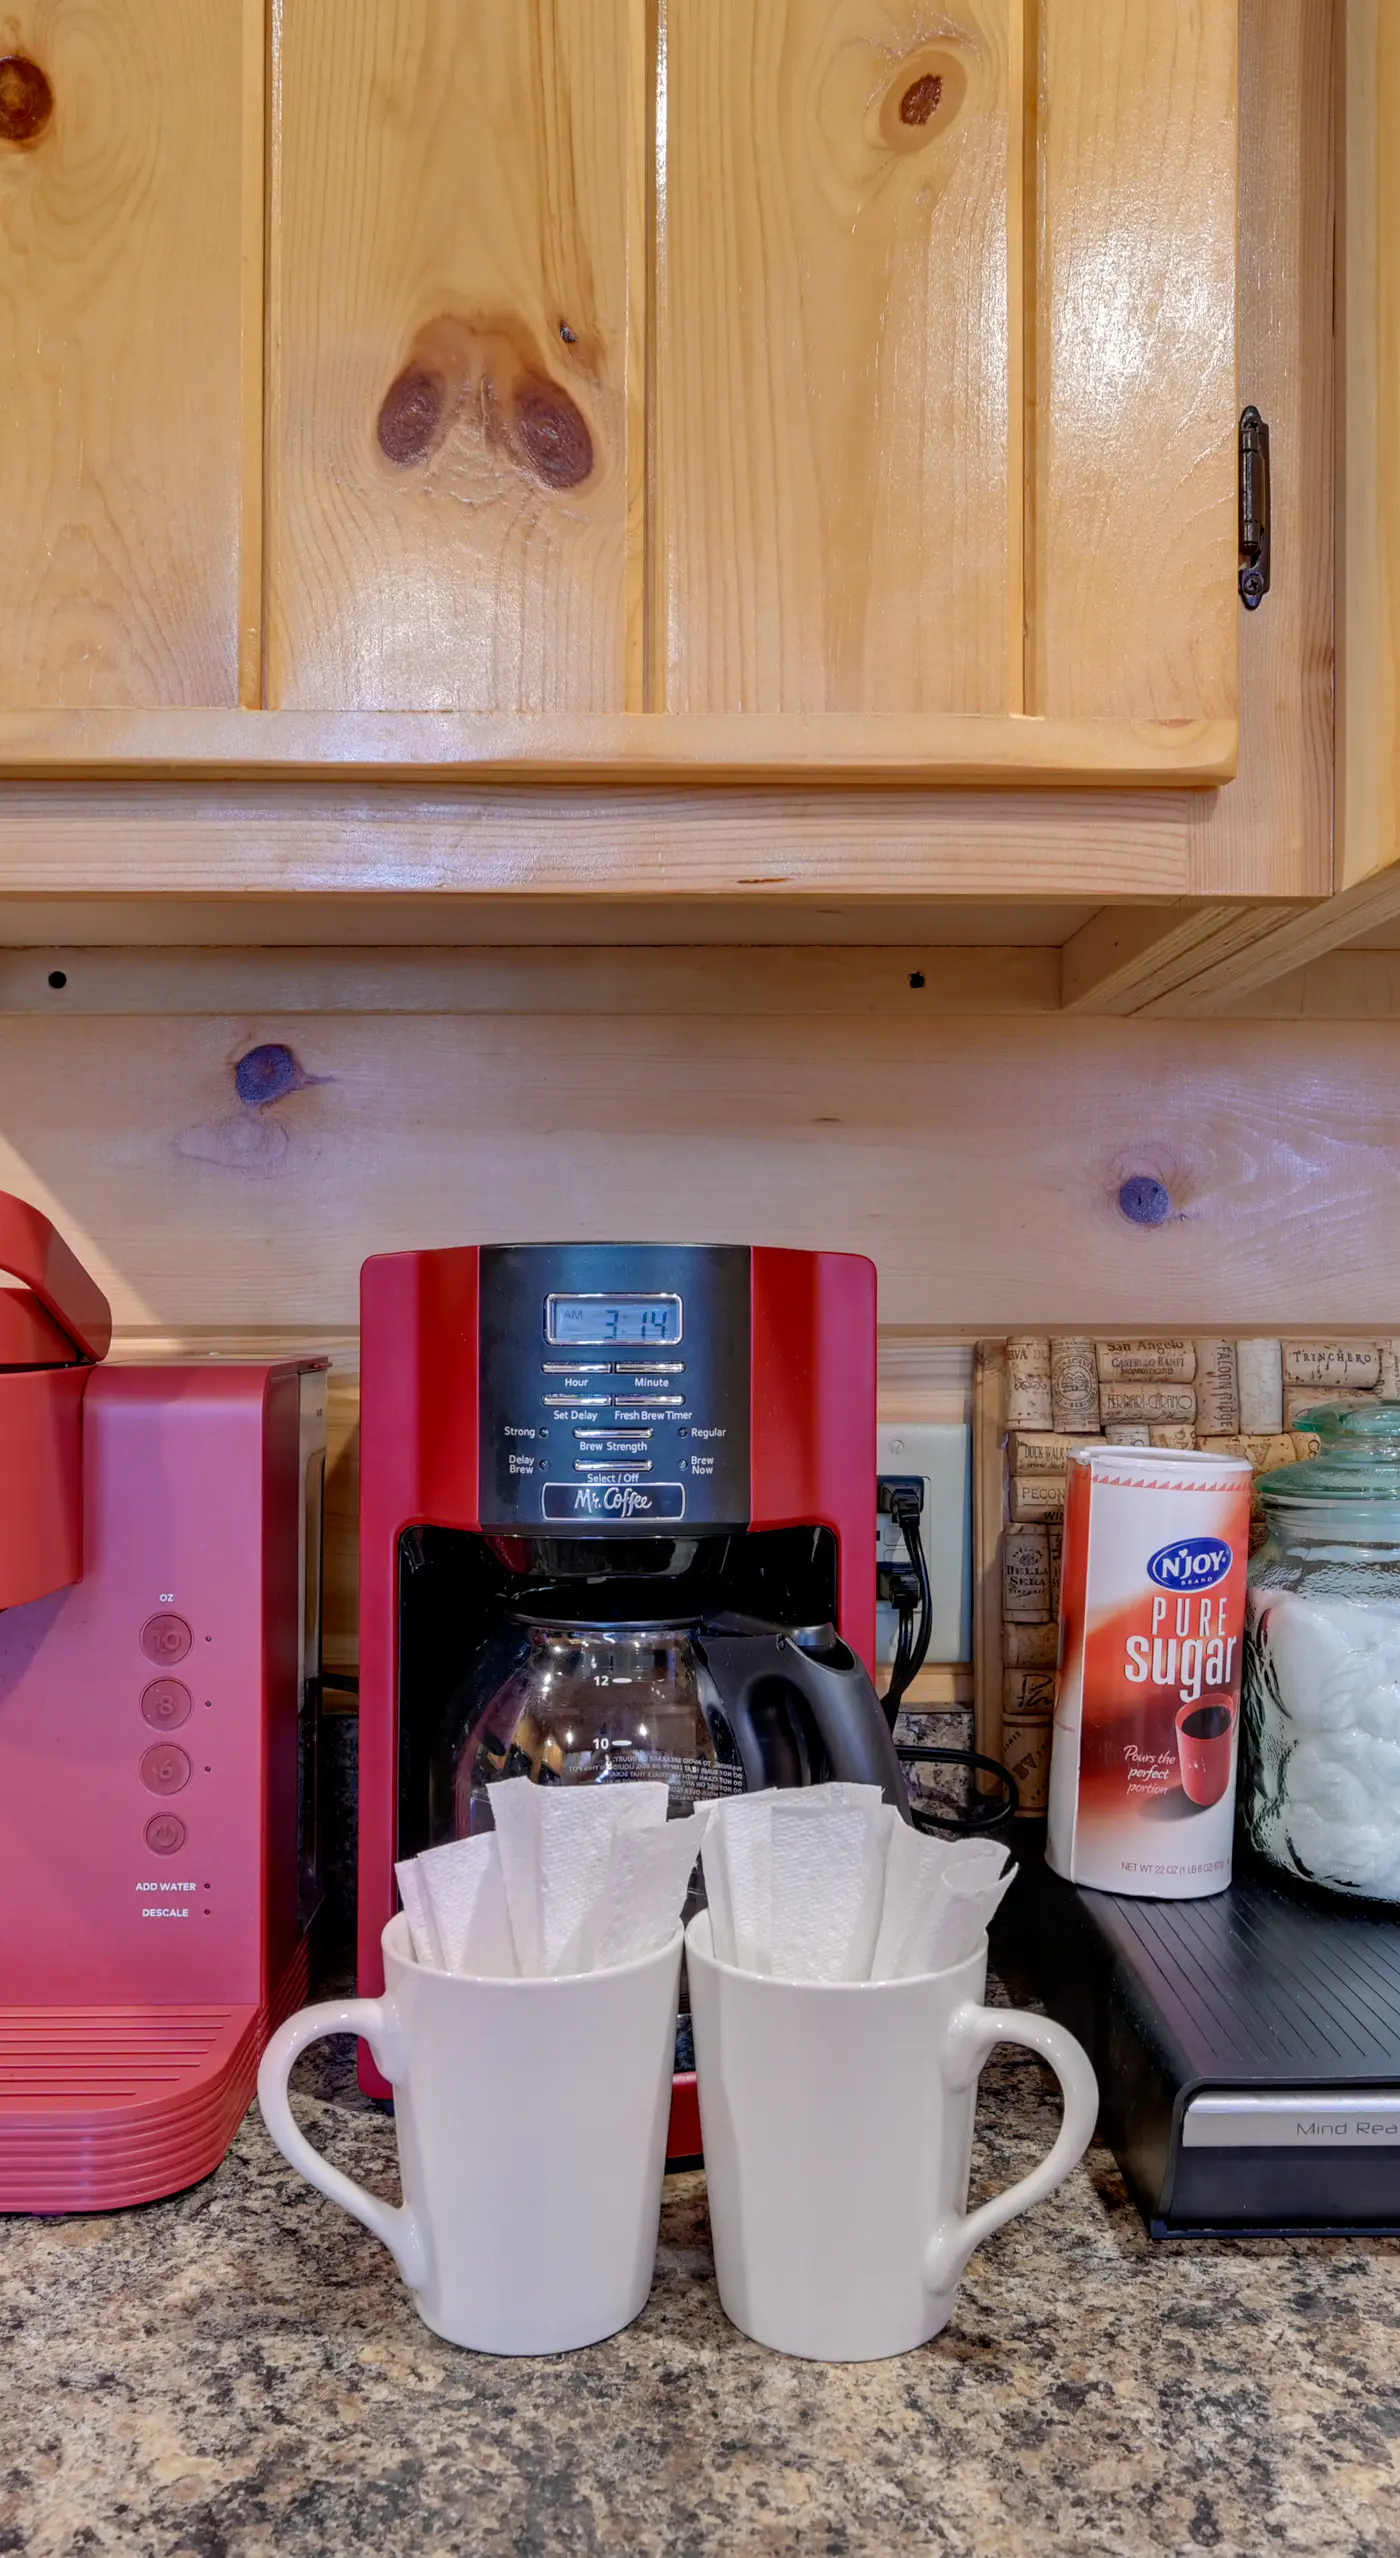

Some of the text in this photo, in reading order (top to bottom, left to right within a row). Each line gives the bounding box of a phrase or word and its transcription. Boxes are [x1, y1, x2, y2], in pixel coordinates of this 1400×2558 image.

[1107, 1342, 1131, 1352] San
[1137, 1340, 1184, 1355] Angelo
[1157, 1357, 1184, 1367] BANFI
[1294, 1350, 1372, 1365] TRINCHERO
[565, 1378, 589, 1387] Hour
[634, 1378, 669, 1387] Minute
[554, 1411, 598, 1423] Set Delay
[614, 1411, 693, 1420] Fresh Brew Timer
[504, 1427, 536, 1439] Strong
[691, 1428, 727, 1439] Regular
[580, 1441, 648, 1454] Brew Strength
[509, 1455, 535, 1467] Delay
[691, 1456, 715, 1465] Brew
[509, 1465, 534, 1474] Brew
[692, 1466, 714, 1475] Now
[587, 1474, 617, 1483] Select
[624, 1474, 640, 1483] Off
[574, 1487, 653, 1517] Mr. Coffee
[1181, 1577, 1213, 1586] BRAND
[1152, 1596, 1228, 1638] PURE
[1124, 1635, 1238, 1703] sugar
[593, 1675, 610, 1687] 12
[160, 1695, 174, 1715] 8
[592, 1738, 610, 1750] 10
[1123, 1744, 1176, 1765] Pours the
[160, 1759, 173, 1778] 6
[1128, 1765, 1170, 1782] perfect
[1126, 1783, 1169, 1795] portion
[1121, 1861, 1138, 1872] NET
[1139, 1864, 1154, 1874] WT
[1155, 1865, 1165, 1875] 22
[1166, 1865, 1178, 1875] OZ
[1187, 1865, 1197, 1874] LB
[136, 1882, 197, 1892] ADD WATER
[142, 1908, 189, 1918] DESCALE
[1296, 2121, 1398, 2136] Mind Rea
